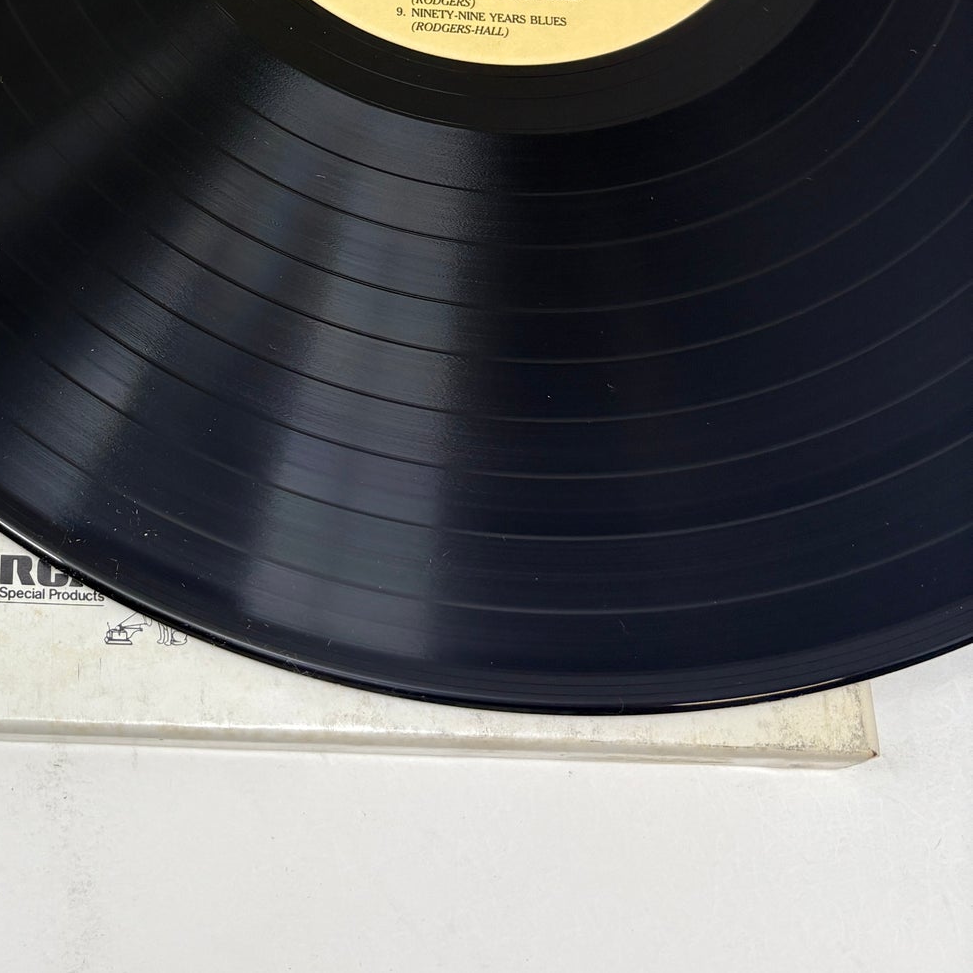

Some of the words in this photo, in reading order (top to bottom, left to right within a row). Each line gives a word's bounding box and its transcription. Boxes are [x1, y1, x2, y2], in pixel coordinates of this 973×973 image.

[396, 7, 406, 17] 9.
[411, 8, 486, 22] NINETY-NINE
[489, 12, 526, 24] YEARS
[530, 15, 567, 27] BLUES
[411, 21, 509, 38] (RODGERS-HALL)
[0, 554, 84, 587] RC
[0, 586, 45, 601] Special
[49, 589, 105, 601] Products
